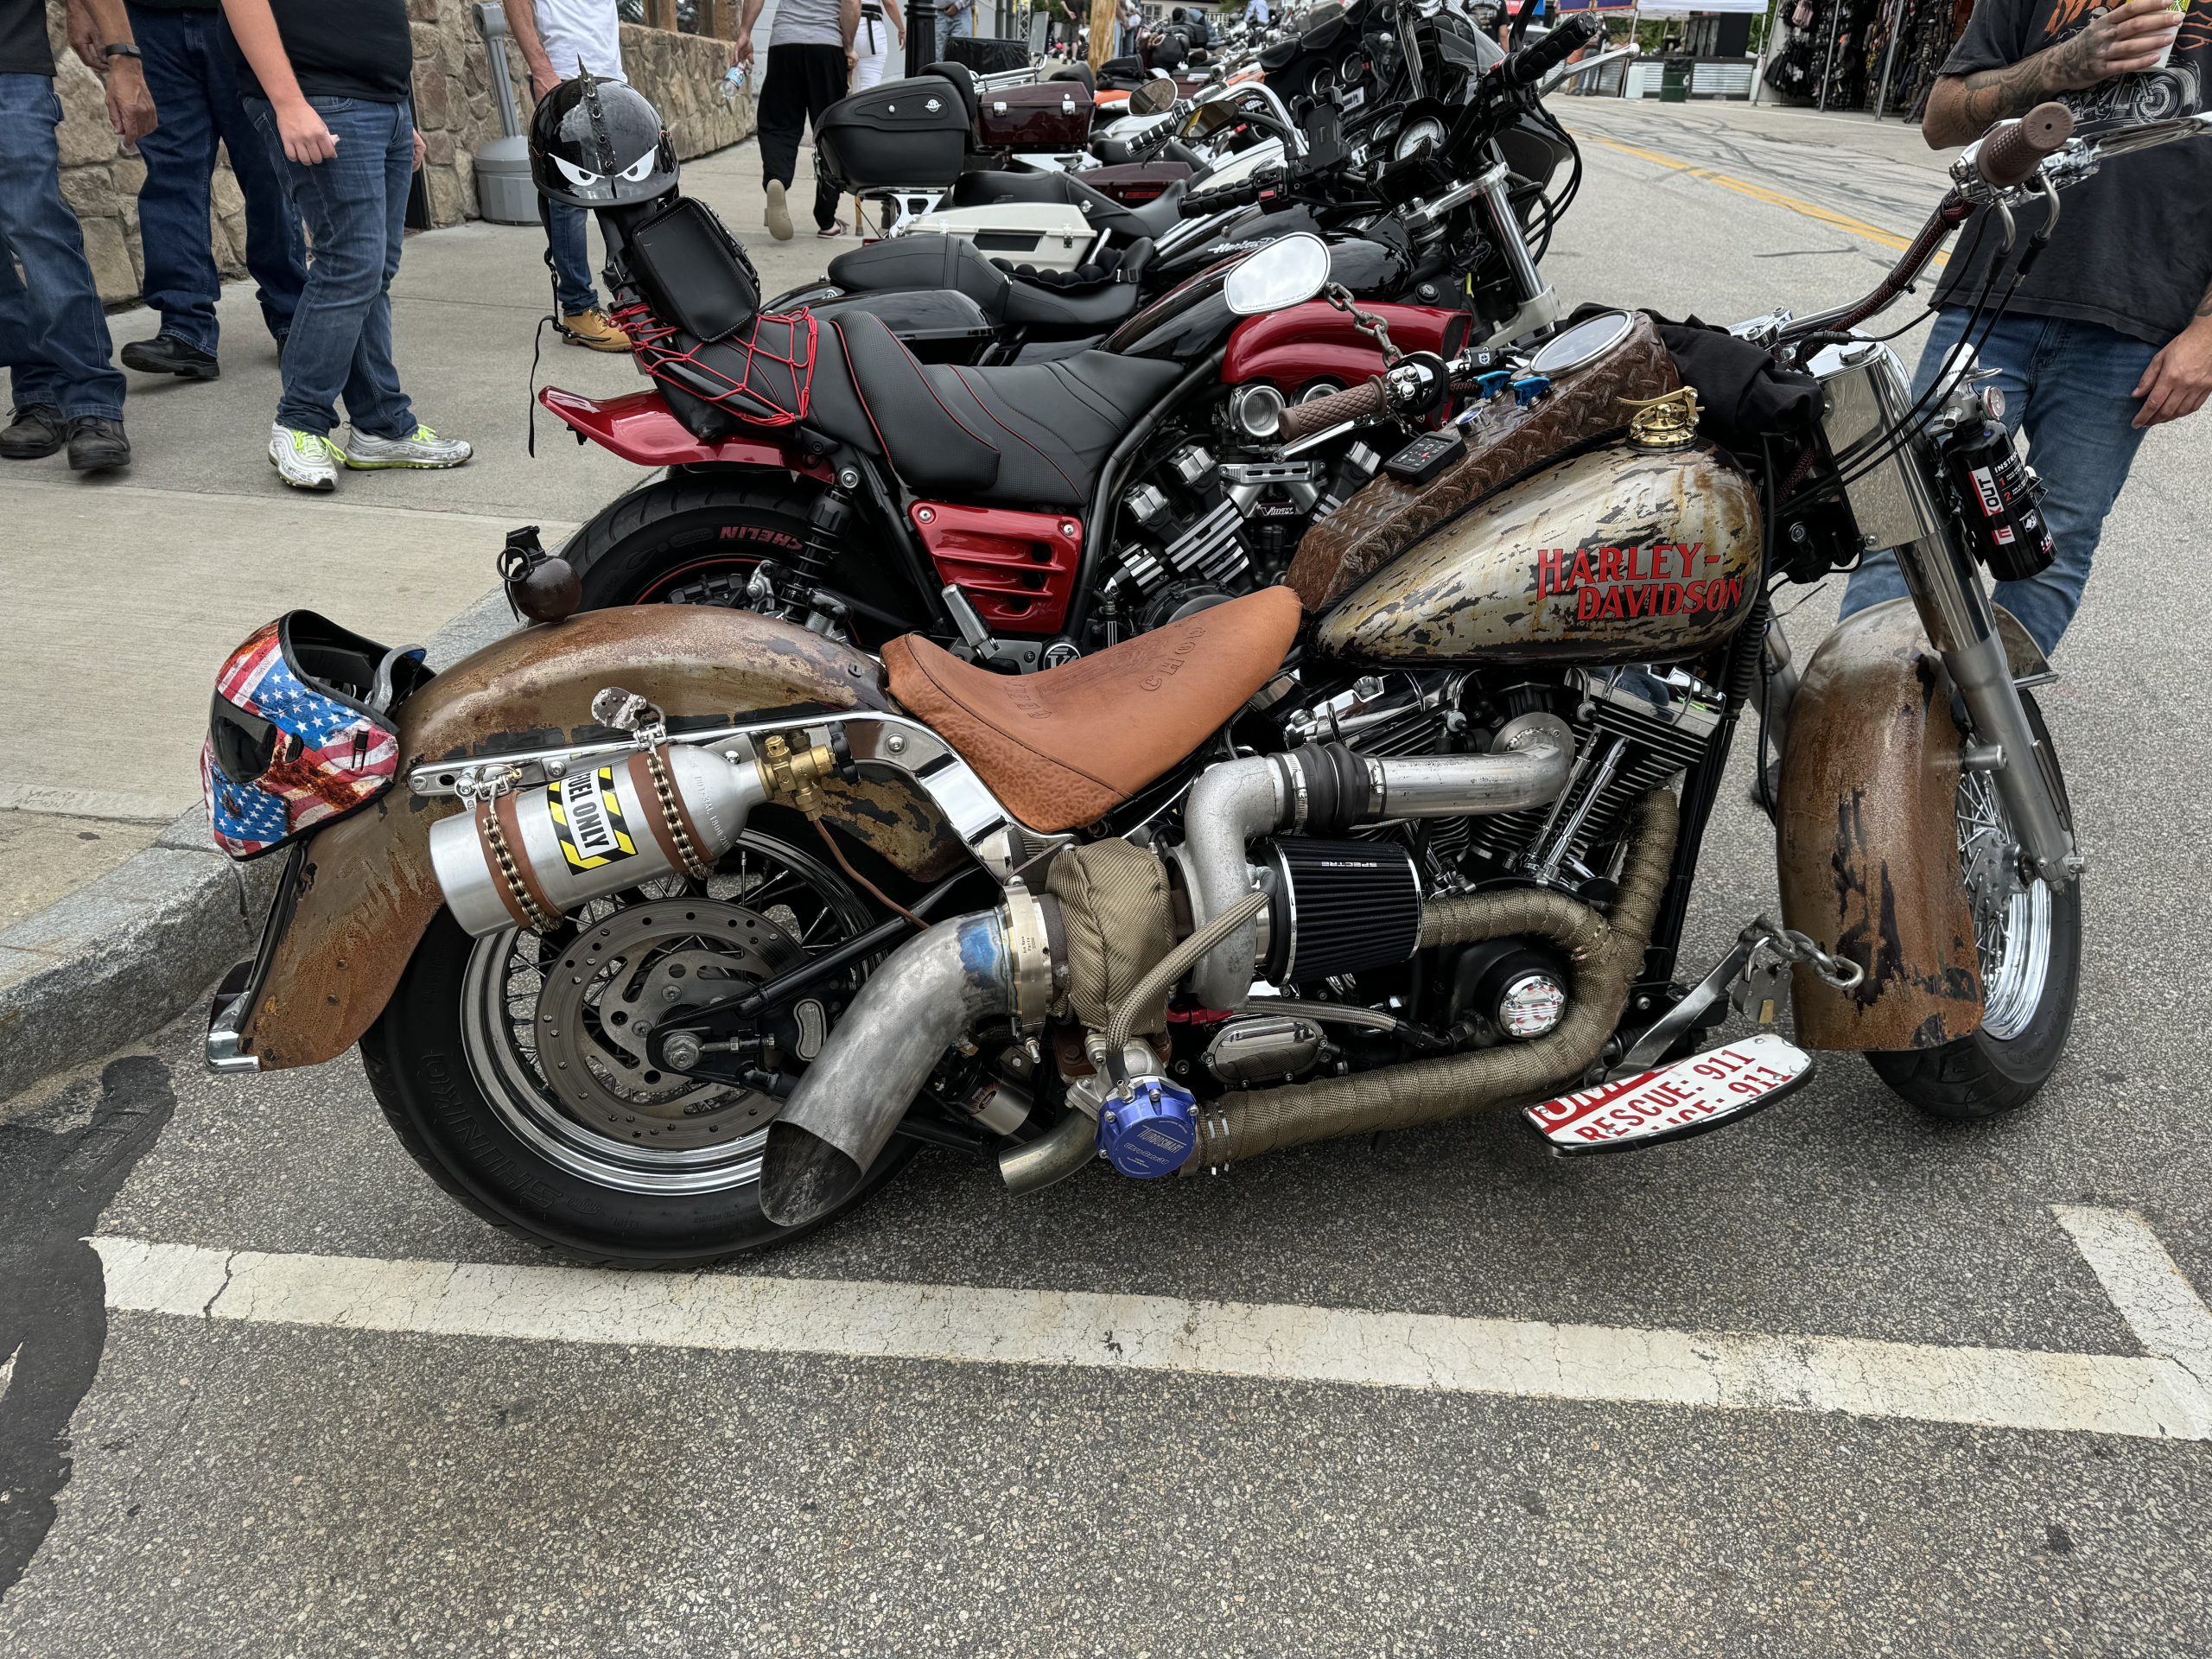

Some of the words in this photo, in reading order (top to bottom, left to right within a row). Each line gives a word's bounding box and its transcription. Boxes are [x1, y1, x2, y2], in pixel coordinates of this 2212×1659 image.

[719, 526, 804, 550] CHELIN
[1535, 542, 1721, 602] HARLEY-
[1577, 575, 1745, 620] DAVIDSON
[572, 801, 610, 849] ONLY
[1573, 1079, 1705, 1141] RESCUE:
[1692, 1049, 1757, 1080] 911
[1727, 1066, 1795, 1097] 911
